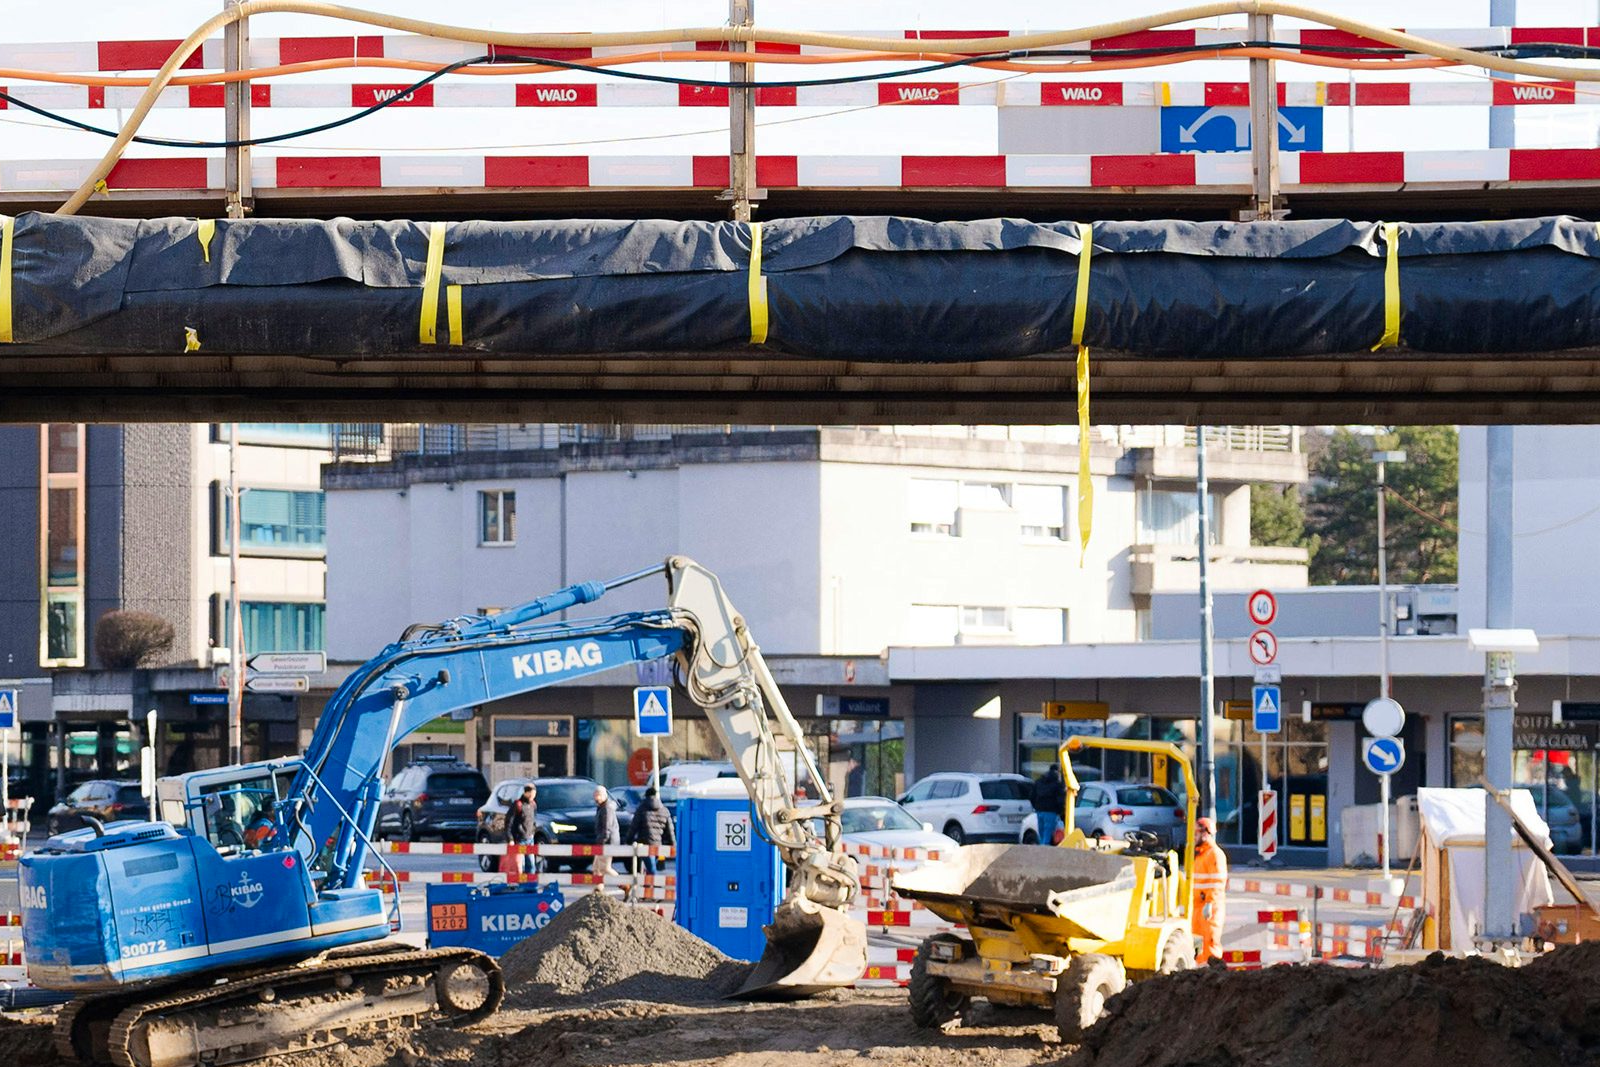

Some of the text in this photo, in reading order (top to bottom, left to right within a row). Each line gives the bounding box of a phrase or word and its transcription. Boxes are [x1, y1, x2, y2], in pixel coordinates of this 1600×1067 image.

[537, 88, 578, 102] WALO
[898, 87, 940, 101] WALO
[1061, 87, 1102, 101] WALO
[1512, 86, 1555, 101] WALO
[512, 642, 603, 680] KIBAG
[847, 701, 882, 713] valiant
[725, 835, 746, 846] TOI
[231, 882, 263, 897] KIBAG
[442, 905, 457, 916] 30
[436, 918, 465, 930] 1202
[481, 913, 550, 932] KIBAG
[122, 939, 167, 958] 30072
